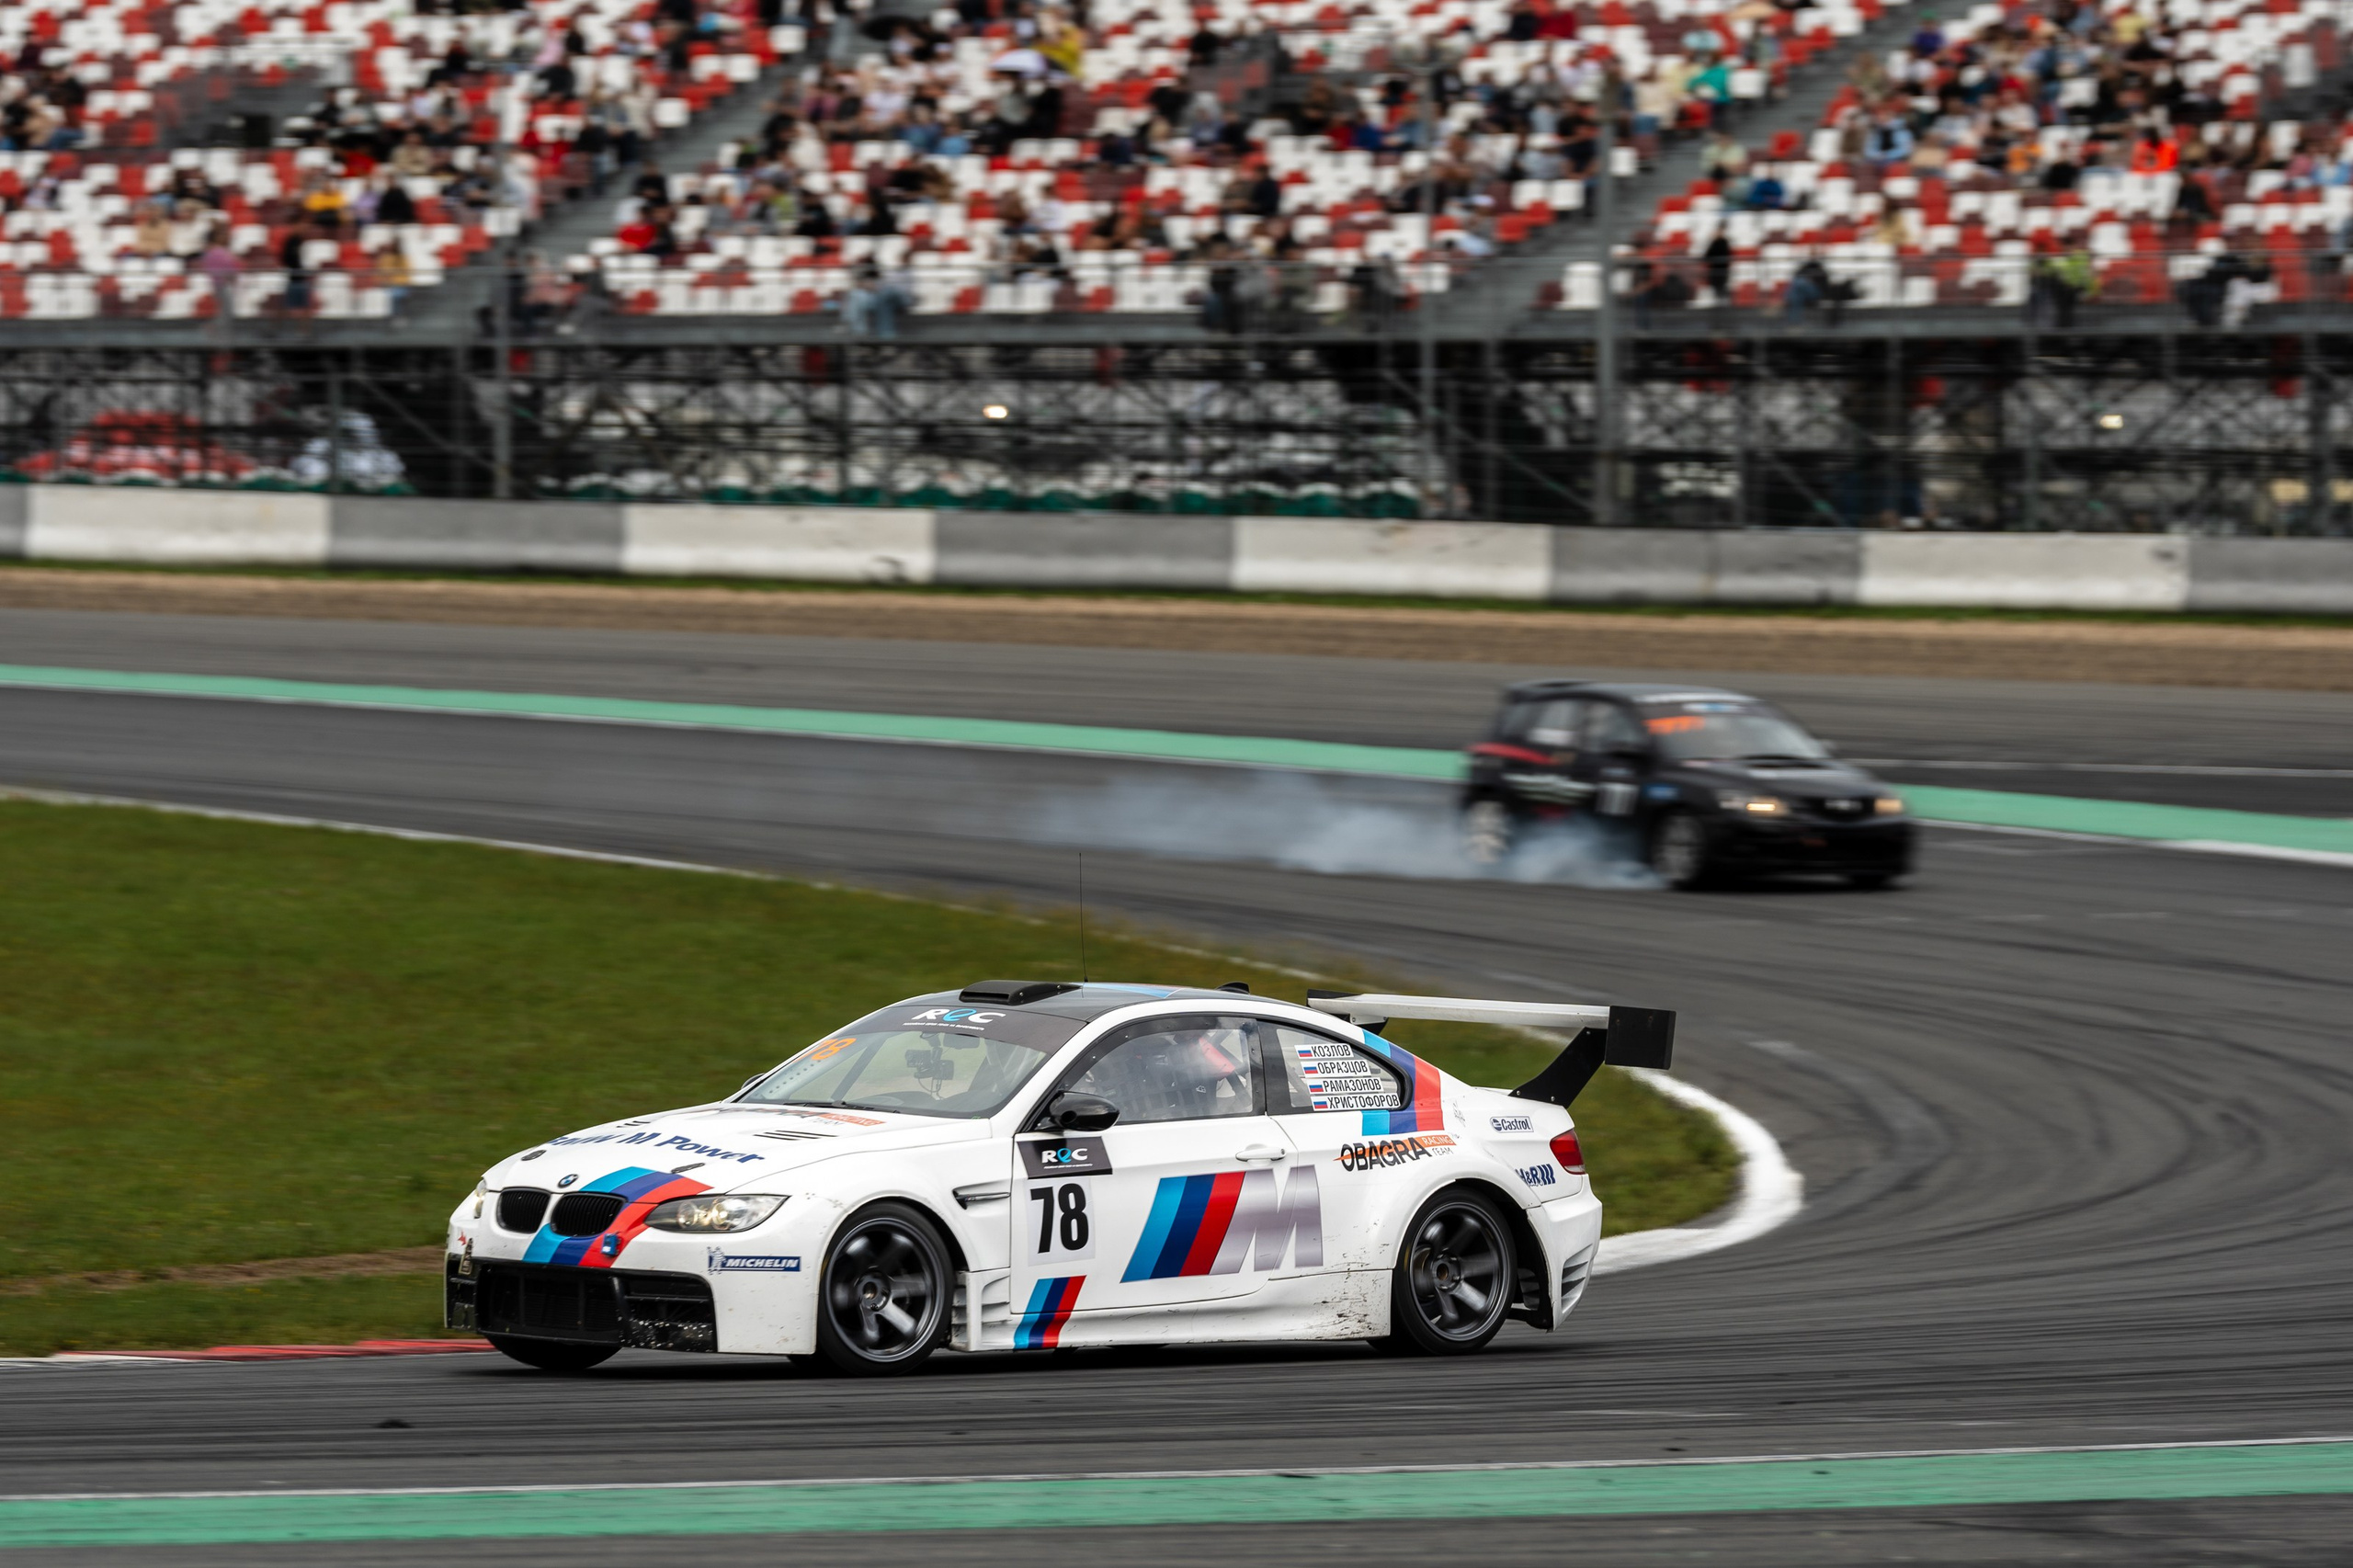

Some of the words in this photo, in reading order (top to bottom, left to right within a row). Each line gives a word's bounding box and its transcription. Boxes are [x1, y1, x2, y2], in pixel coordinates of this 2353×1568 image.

[1311, 1044, 1351, 1057] КОЗЛОВ
[1317, 1060, 1369, 1074] ОБРАЗЦОВ
[1323, 1078, 1381, 1092] РАМАЗОНОВ
[1327, 1094, 1400, 1108] ХРИСТОФОРОВ
[1500, 1118, 1531, 1131] Castrol
[615, 1132, 662, 1144] M
[654, 1135, 765, 1163] Power
[1340, 1137, 1433, 1172] OBAGRA
[1421, 1134, 1454, 1145] RACING
[1431, 1146, 1454, 1156] TEAM
[1030, 1183, 1089, 1254] 78
[1208, 1165, 1324, 1275] M
[725, 1258, 799, 1267] MICHELIN
